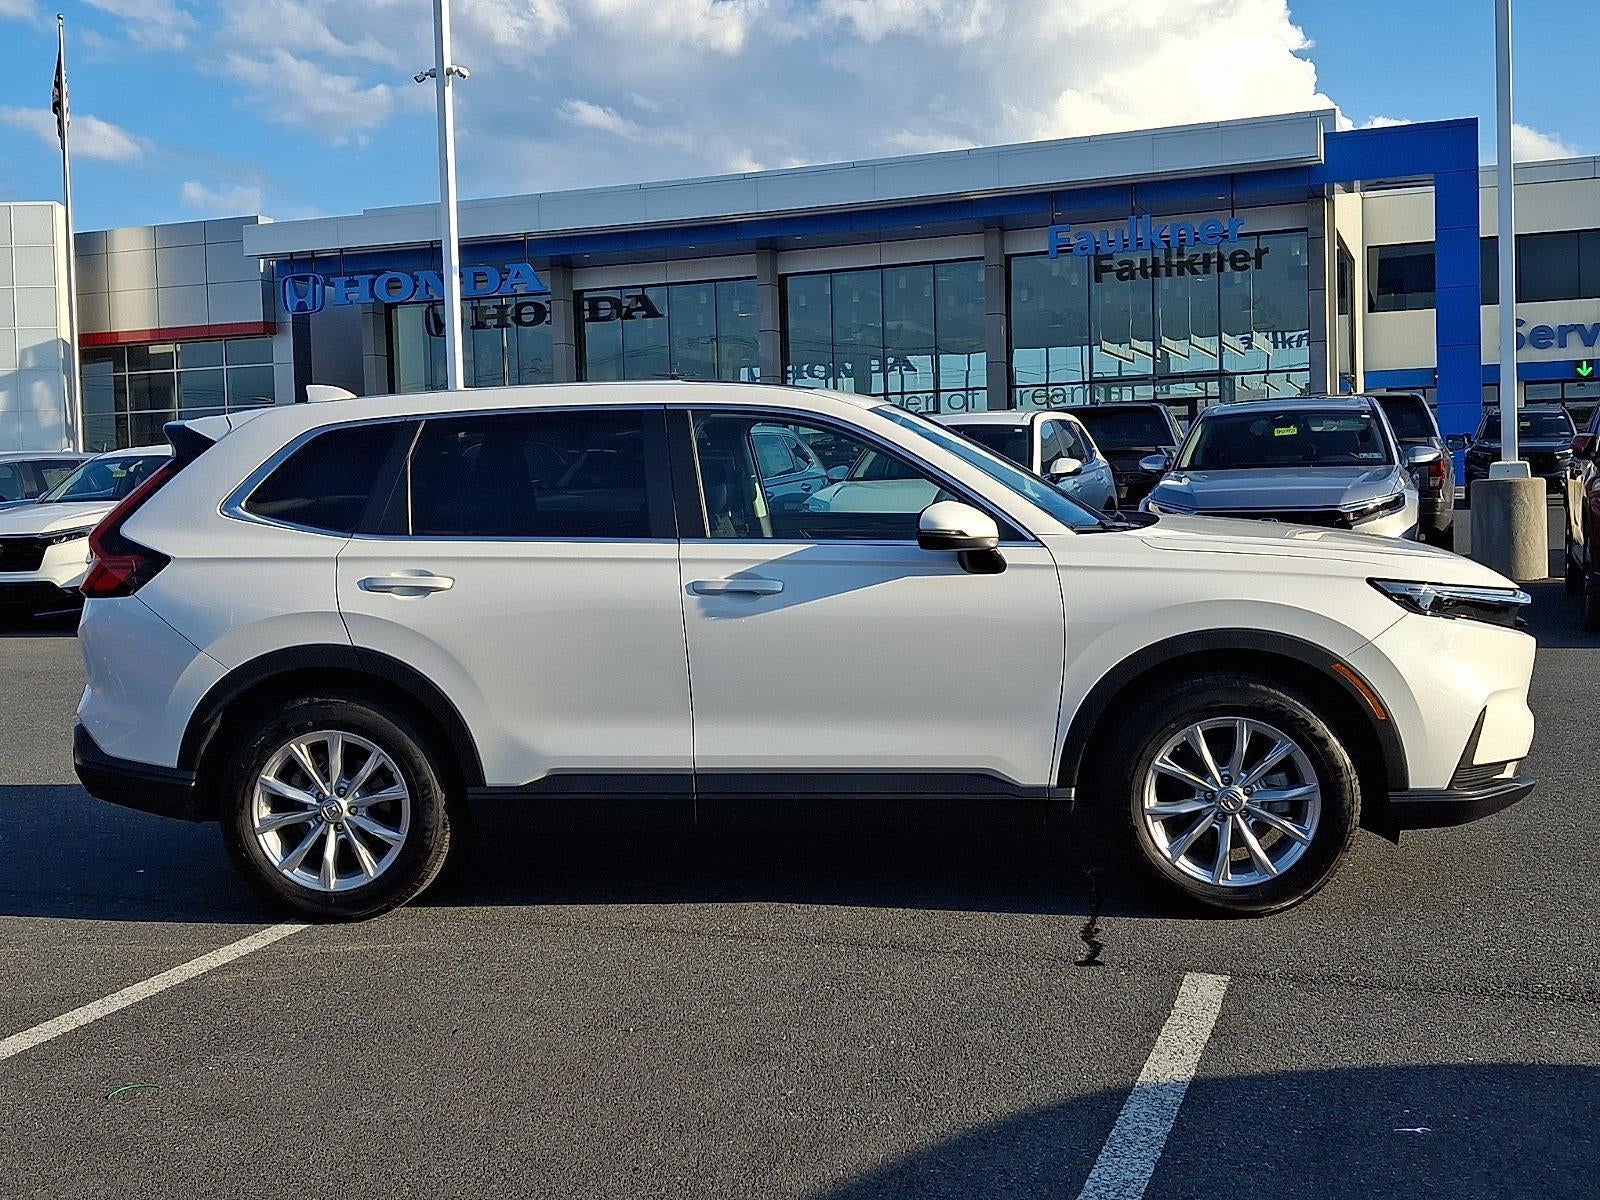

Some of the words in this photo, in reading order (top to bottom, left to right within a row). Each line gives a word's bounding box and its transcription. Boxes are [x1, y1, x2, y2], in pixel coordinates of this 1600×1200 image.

[1048, 213, 1245, 259] Faulkner
[330, 263, 549, 306] HONDA
[1093, 246, 1269, 283] Faulkner
[470, 295, 664, 329] HODA
